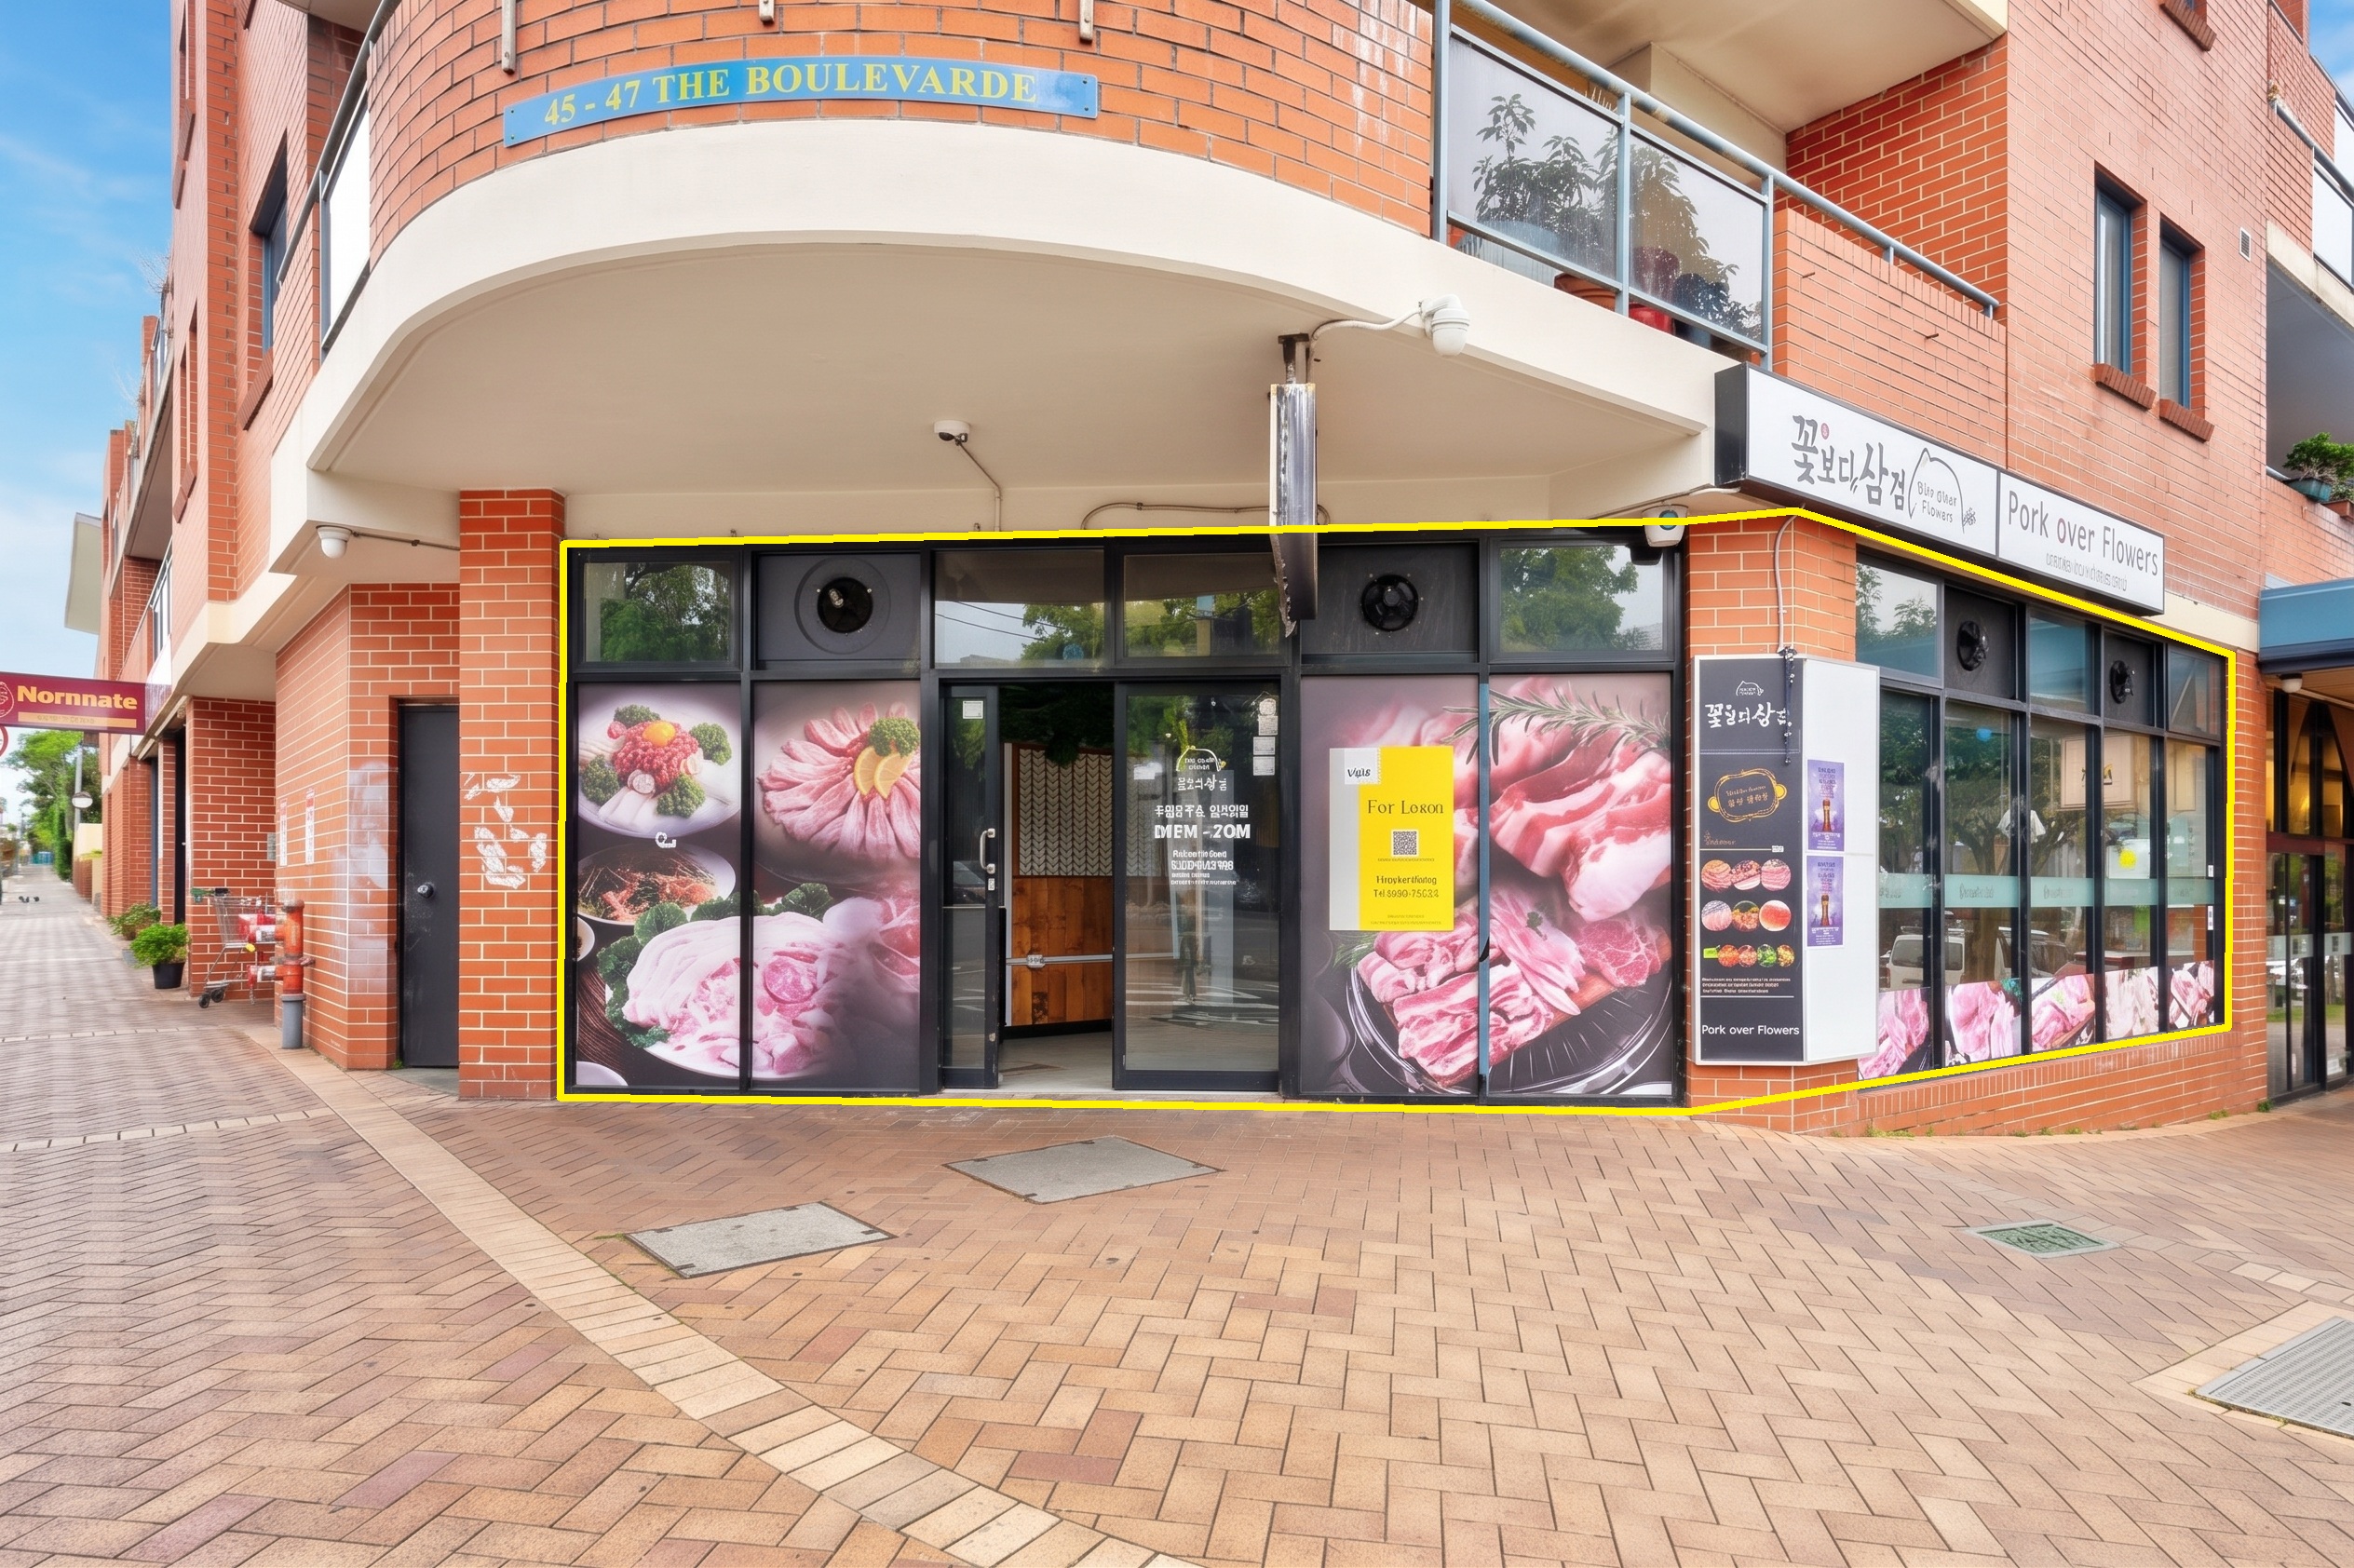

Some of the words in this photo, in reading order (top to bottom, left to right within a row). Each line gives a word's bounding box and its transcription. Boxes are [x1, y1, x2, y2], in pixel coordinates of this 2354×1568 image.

[544, 93, 576, 126] 45
[605, 79, 642, 111] 47
[652, 69, 730, 104] THE
[746, 62, 1037, 103] BOULEVARDE
[1922, 499, 1954, 523] Flowers
[2009, 490, 2049, 538] Pork
[2057, 518, 2095, 553] over
[2103, 525, 2158, 576] Flowers
[17, 685, 138, 710] Nornnate
[1368, 800, 1395, 815] For
[1729, 1026, 1754, 1034] over
[1758, 1024, 1800, 1034] Flowers
